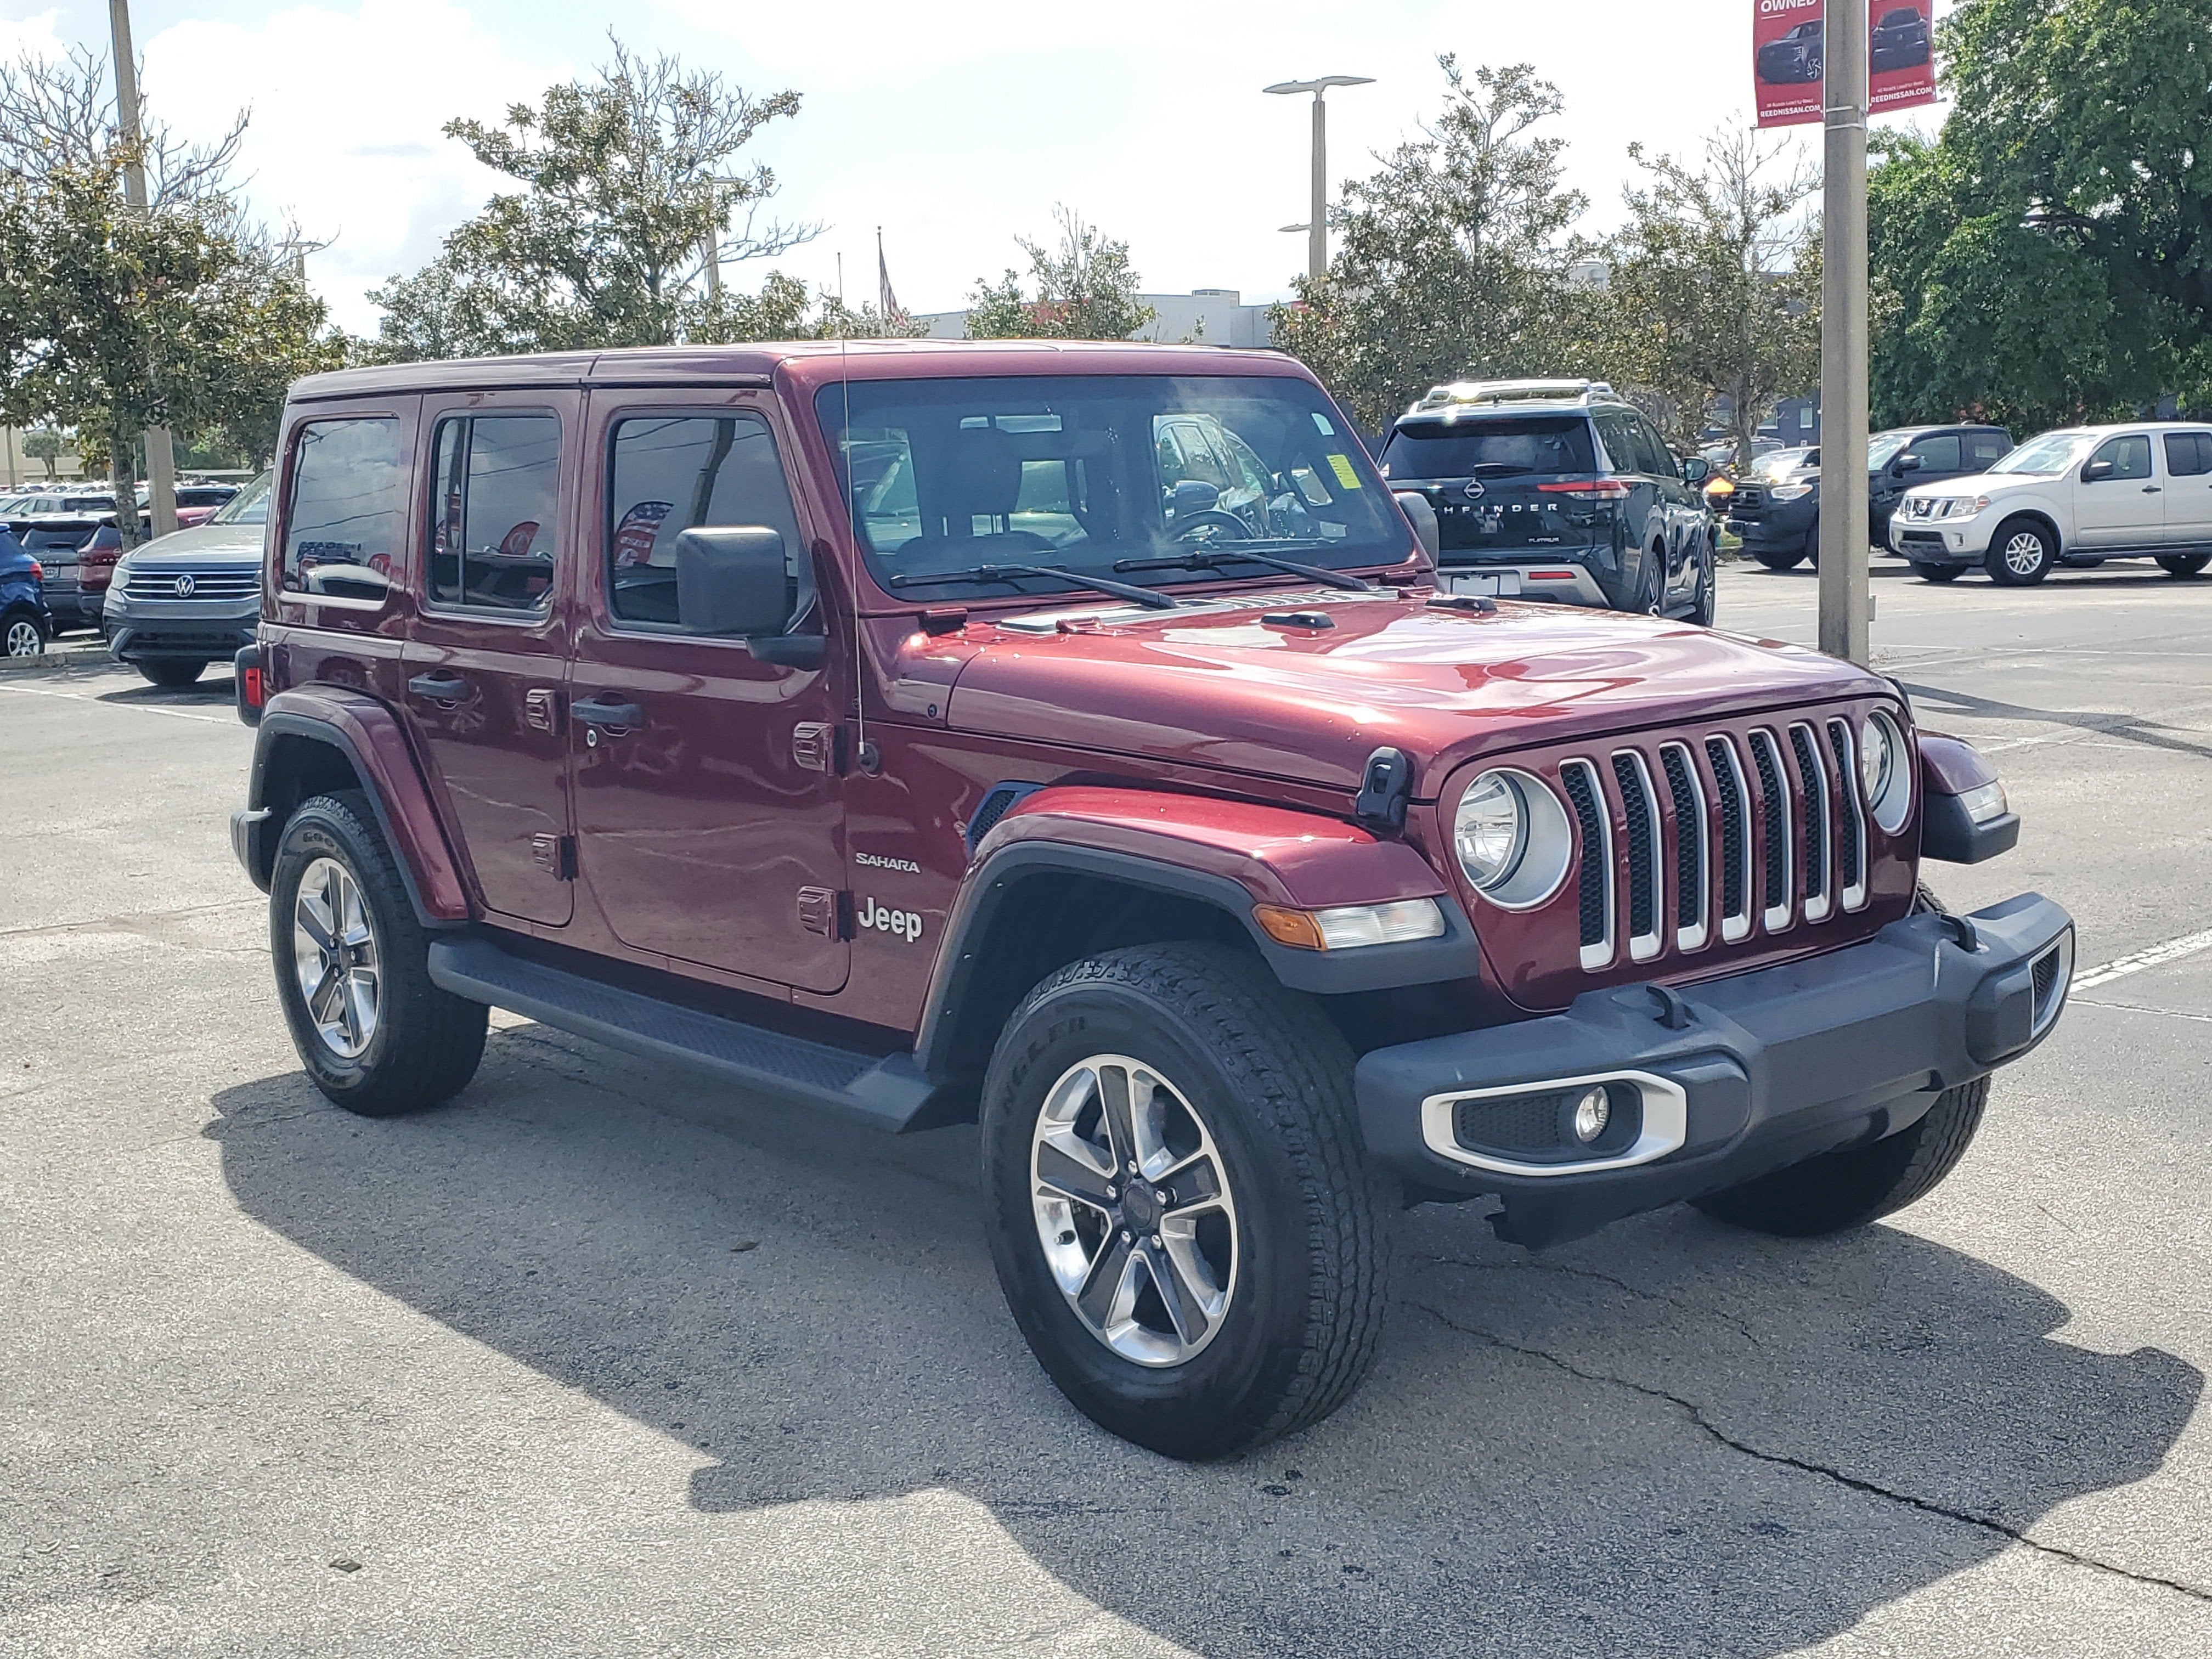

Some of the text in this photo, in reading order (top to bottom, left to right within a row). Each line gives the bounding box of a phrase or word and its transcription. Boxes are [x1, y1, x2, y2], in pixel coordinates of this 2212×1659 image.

[1870, 86, 1932, 103] REEDNISSAN.COM
[1760, 104, 1821, 117] REEDNISSAN.COM
[1430, 503, 1558, 515] HFINDER
[855, 852, 922, 874] SAHARA
[857, 896, 923, 943] Jeep
